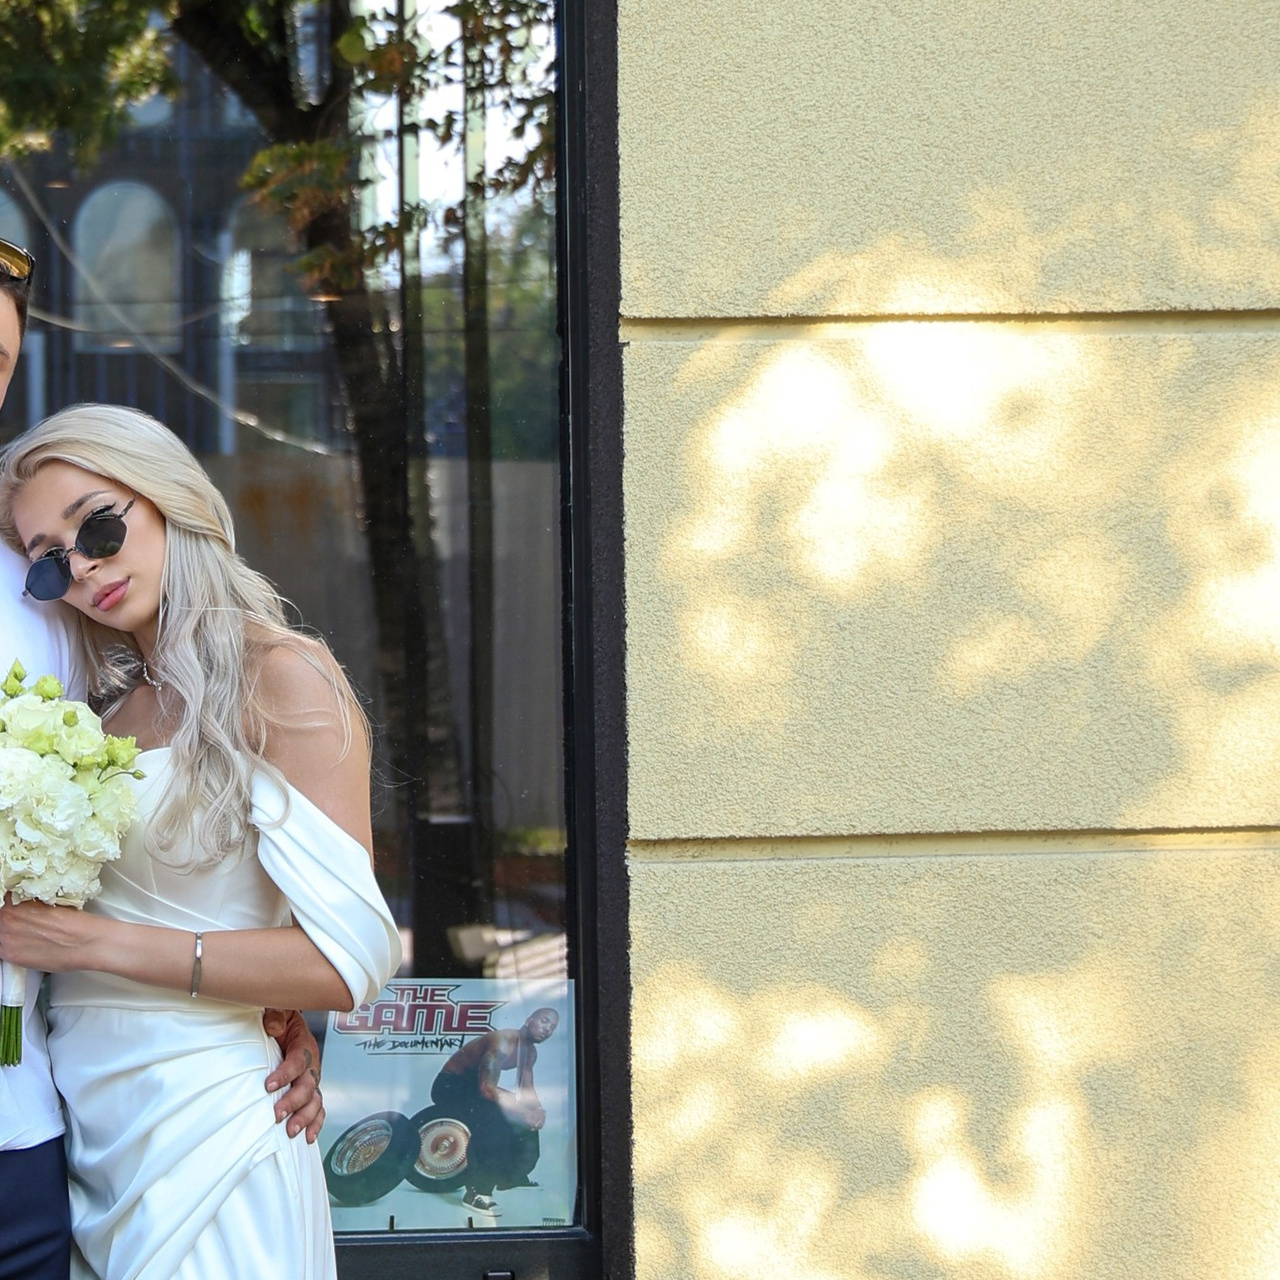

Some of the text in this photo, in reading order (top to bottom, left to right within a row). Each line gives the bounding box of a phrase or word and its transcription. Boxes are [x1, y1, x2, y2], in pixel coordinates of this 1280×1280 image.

[391, 987, 450, 1003] THE
[337, 1003, 500, 1032] GAME
[356, 1035, 465, 1052] THE DOCUMENTARY
